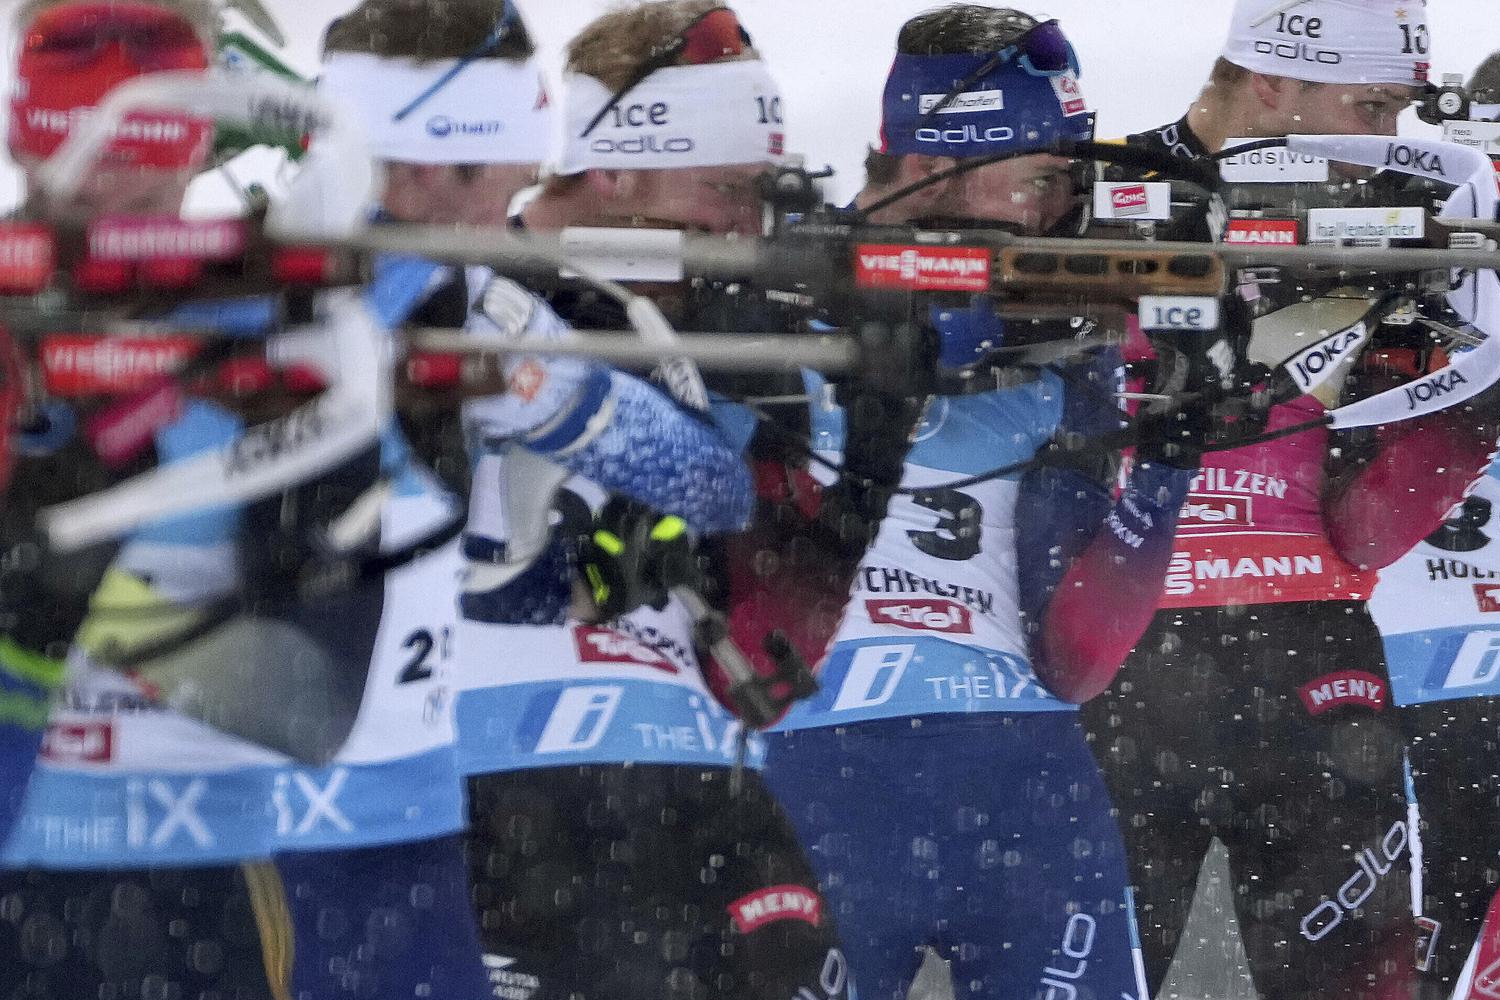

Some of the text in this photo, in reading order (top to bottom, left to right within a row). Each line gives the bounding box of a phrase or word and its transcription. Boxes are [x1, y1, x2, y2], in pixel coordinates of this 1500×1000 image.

[1254, 40, 1342, 65] odlo
[590, 134, 696, 153] odlo
[915, 124, 1014, 143] odlo
[1384, 142, 1446, 176] JOKA
[1152, 306, 1202, 327] ice
[1295, 331, 1360, 387] JOKA
[1404, 369, 1467, 410] JOKA
[923, 675, 993, 701] THE
[1309, 679, 1381, 706] MENY
[631, 723, 697, 752] THE
[126, 775, 215, 848] iX
[270, 767, 357, 838] iX
[1299, 820, 1409, 942] odlo
